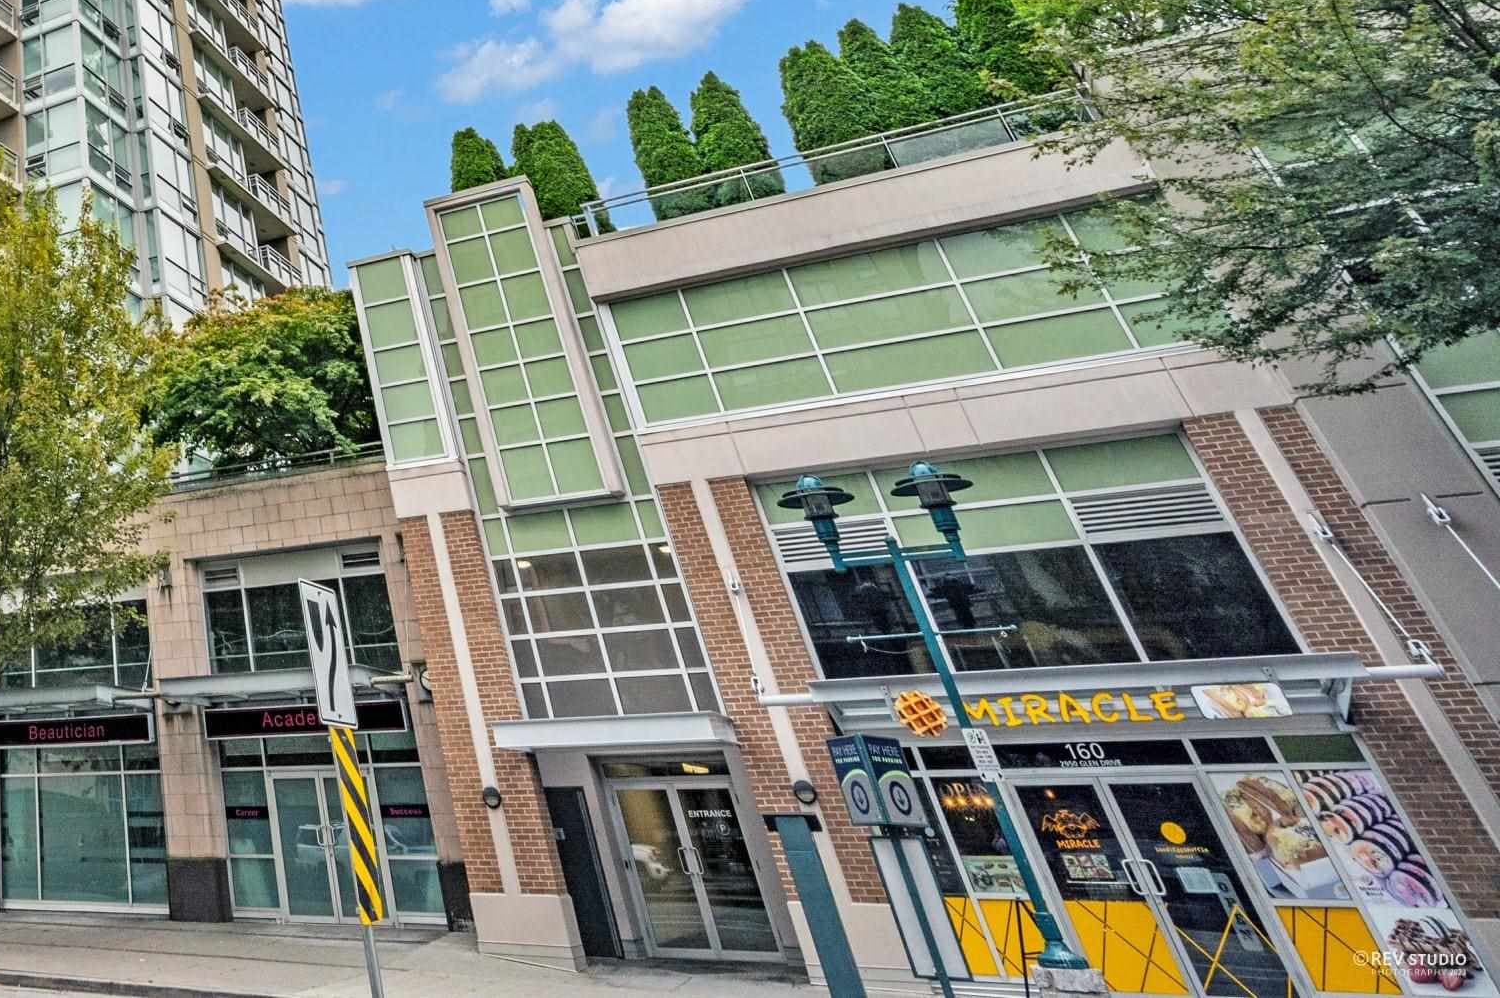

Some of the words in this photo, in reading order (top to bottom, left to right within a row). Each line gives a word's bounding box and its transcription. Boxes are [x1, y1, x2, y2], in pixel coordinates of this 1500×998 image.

[962, 690, 1186, 727] MIRACLE
[262, 708, 319, 729] Acade
[29, 724, 105, 740] Beautician
[867, 743, 881, 755] PAY
[881, 745, 901, 757] HERE
[1064, 742, 1105, 760] 160
[1080, 759, 1100, 768] GLEN
[1100, 759, 1123, 768] DRIVE
[688, 810, 732, 818] ENTRANCE
[1055, 838, 1100, 850] MIRACLE
